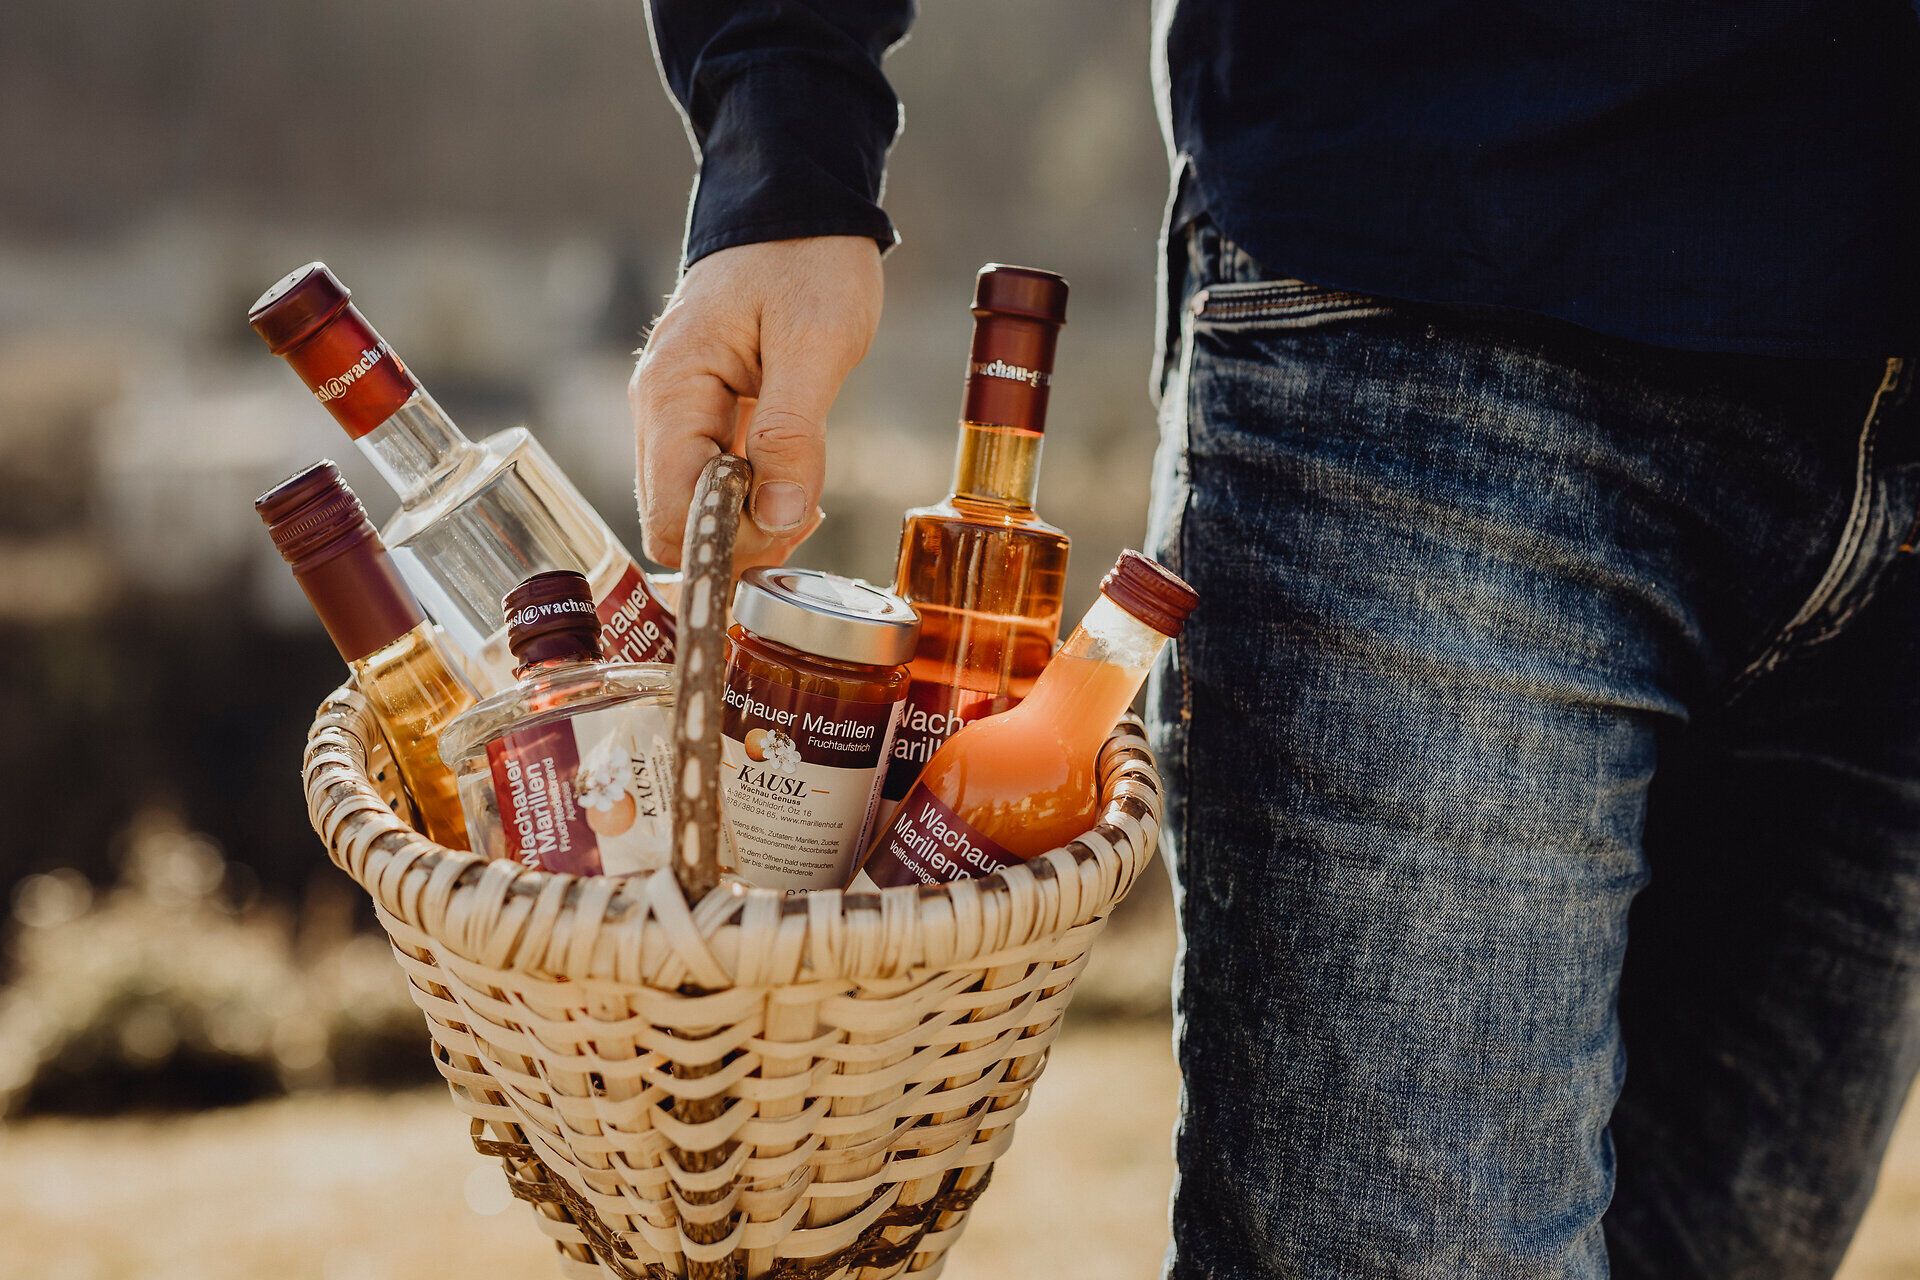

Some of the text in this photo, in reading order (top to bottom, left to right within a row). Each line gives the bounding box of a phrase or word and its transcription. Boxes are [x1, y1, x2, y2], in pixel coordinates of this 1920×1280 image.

[802, 712, 875, 739] Marillen
[807, 736, 871, 752] Fruchtaufstrich
[631, 752, 658, 818] KAUSL
[737, 764, 808, 798] KAUSL
[740, 782, 801, 806] Wachau Genuss
[525, 762, 558, 854] Marillen
[889, 840, 941, 886] Vollfruchtiger
